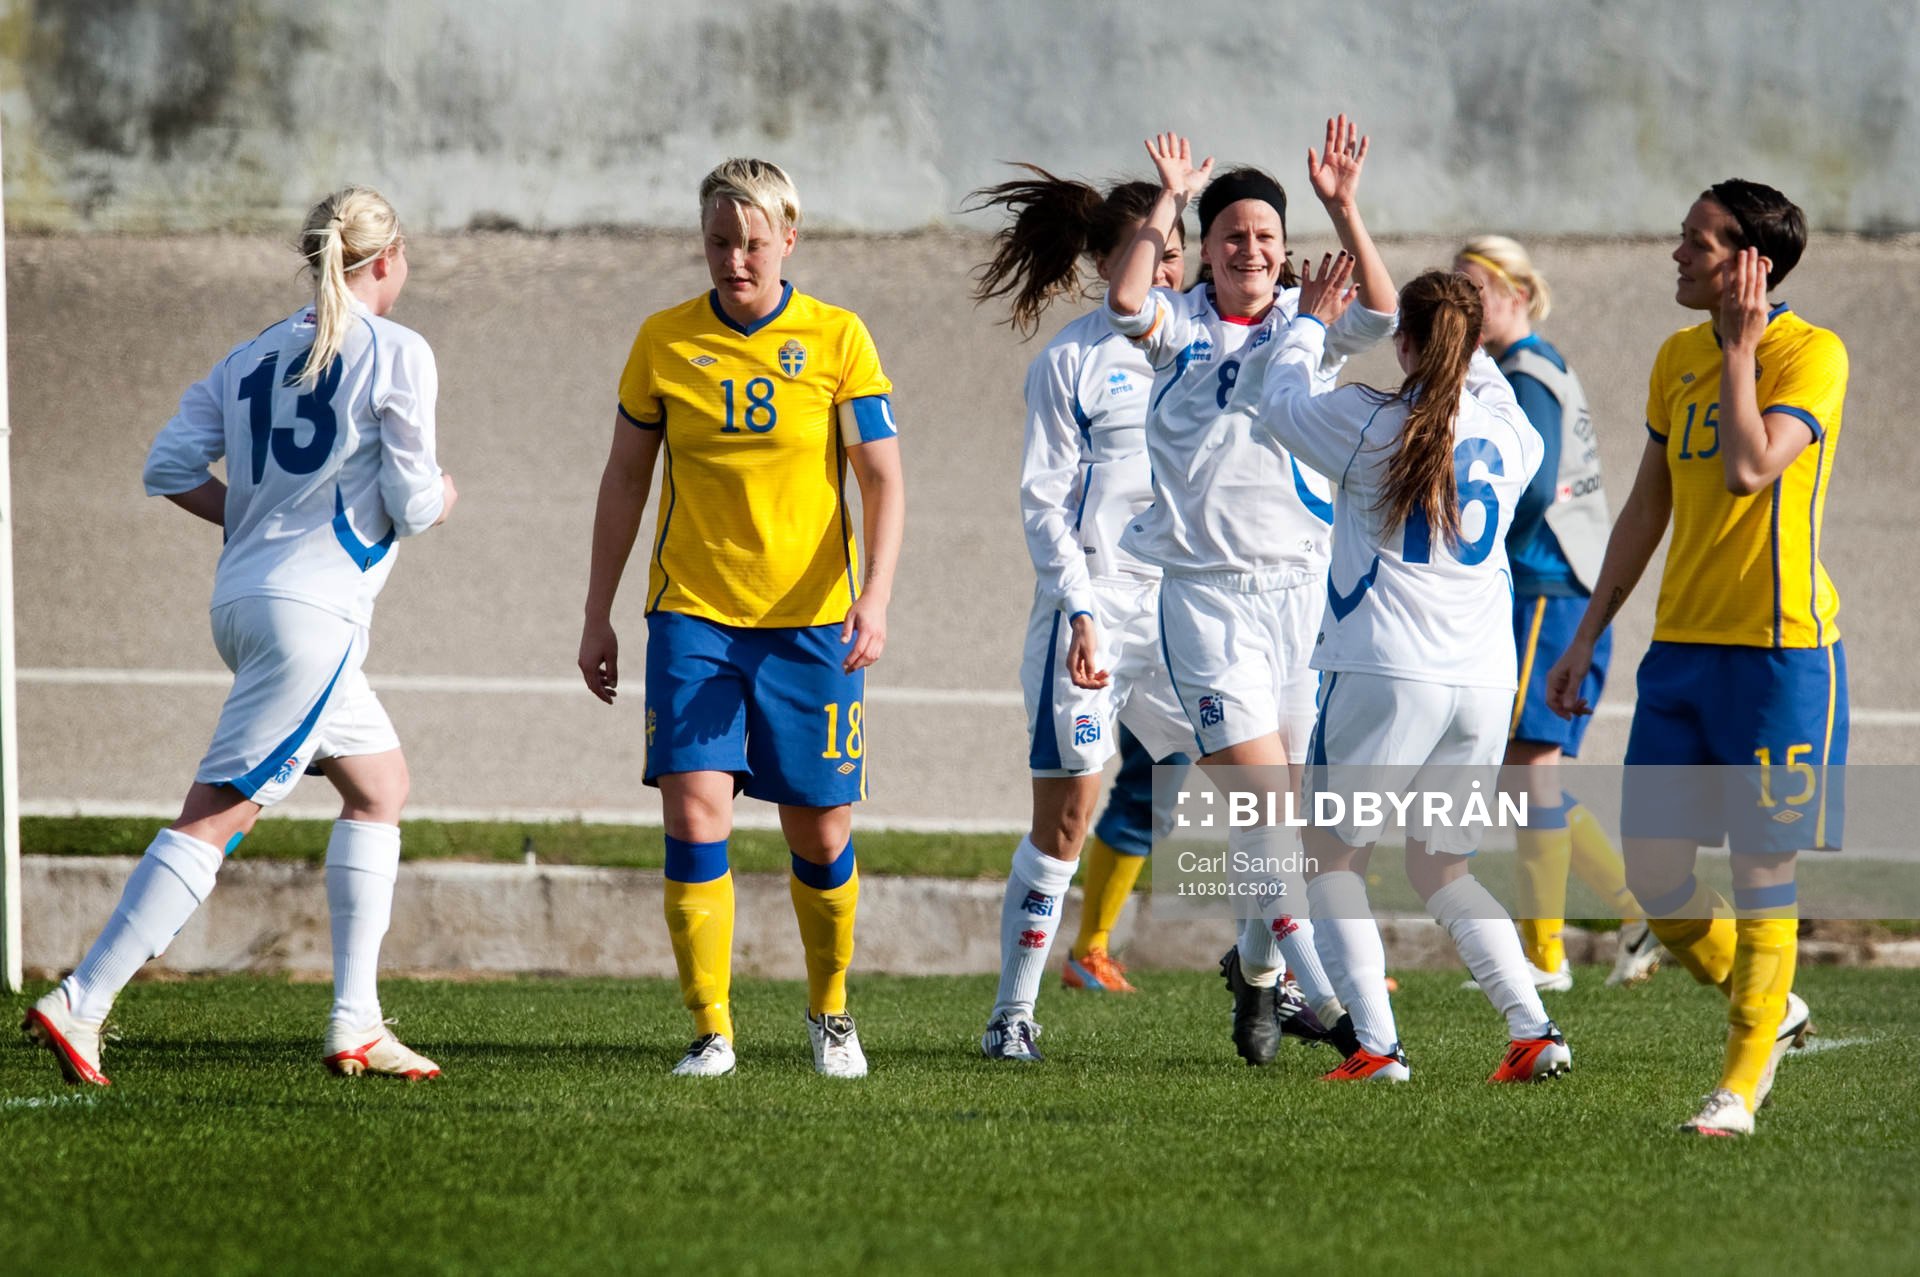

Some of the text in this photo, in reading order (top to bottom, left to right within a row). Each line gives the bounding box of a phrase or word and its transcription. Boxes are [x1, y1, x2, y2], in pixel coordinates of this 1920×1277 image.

[719, 377, 778, 434] 18
[1216, 360, 1241, 409] 8
[238, 350, 343, 485] 13
[1678, 402, 1720, 460] 15
[822, 701, 862, 759] 18
[1754, 743, 1816, 807] 15
